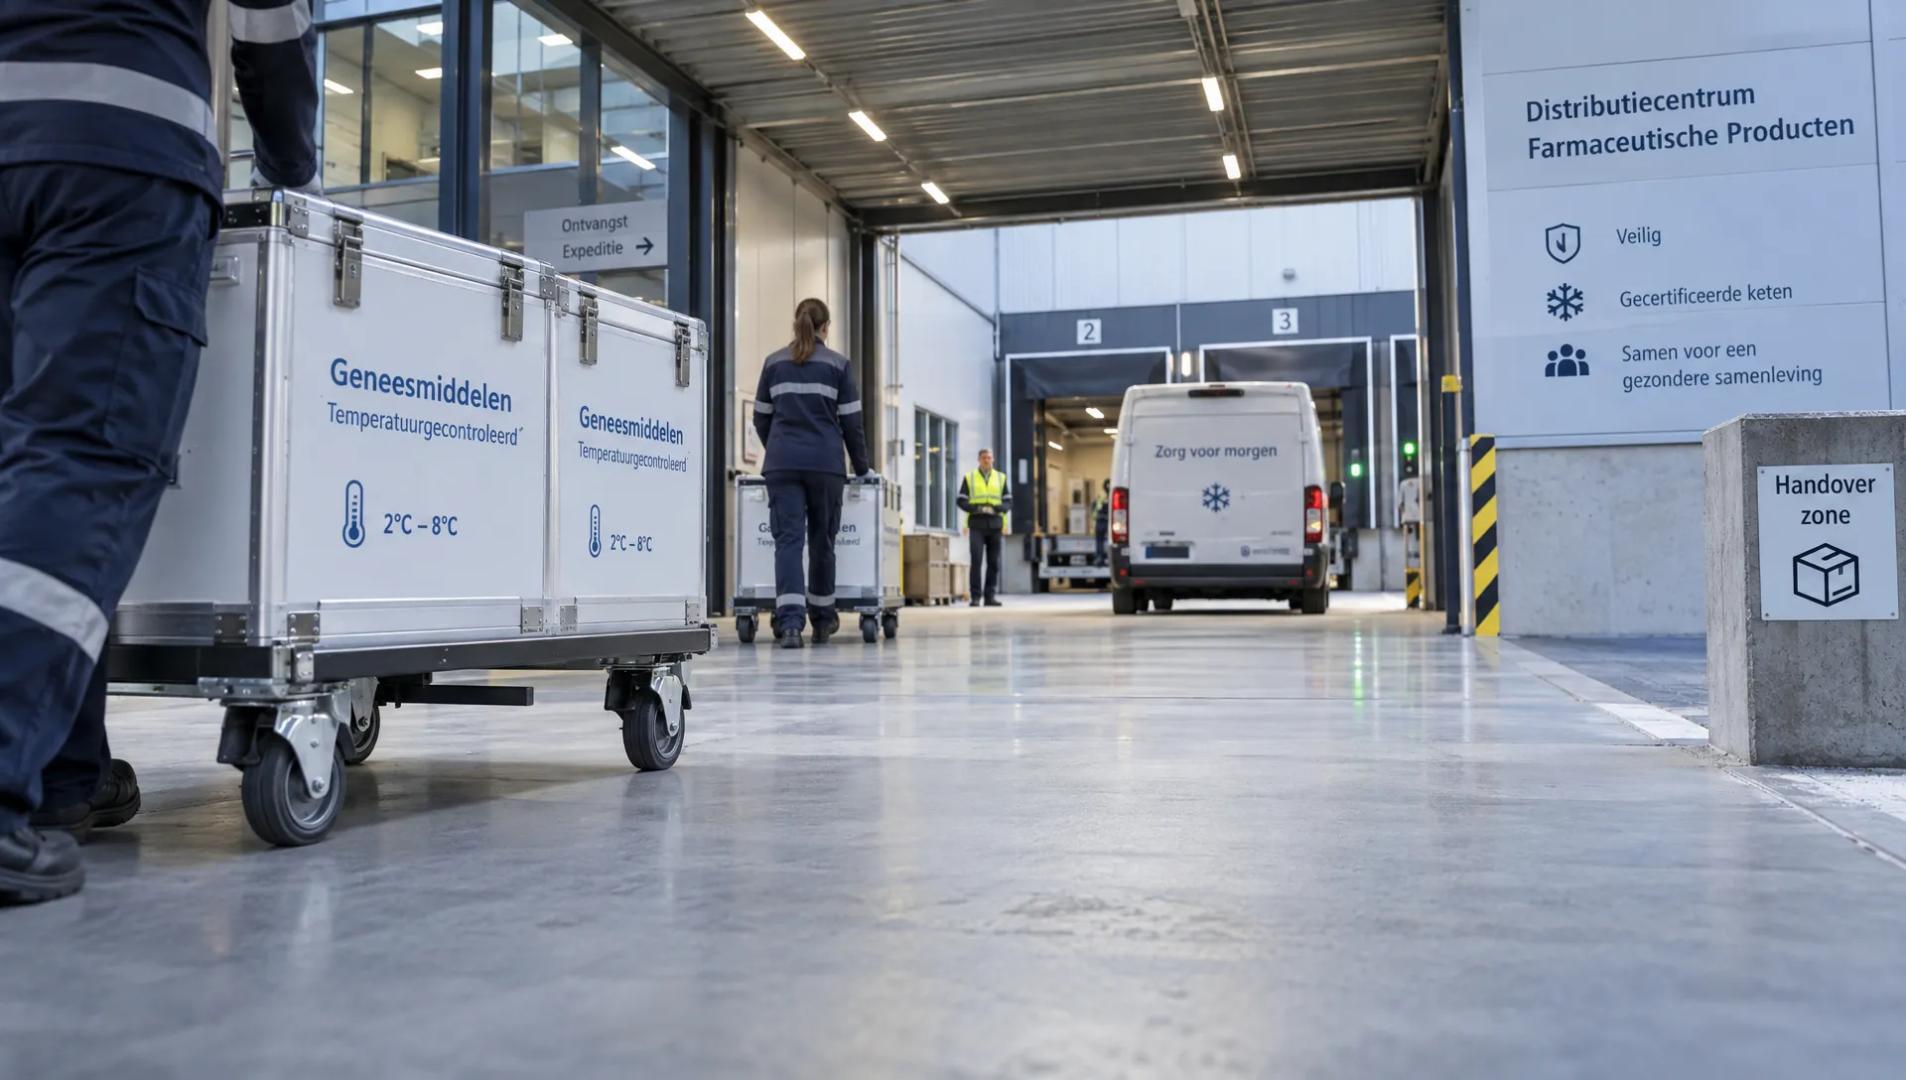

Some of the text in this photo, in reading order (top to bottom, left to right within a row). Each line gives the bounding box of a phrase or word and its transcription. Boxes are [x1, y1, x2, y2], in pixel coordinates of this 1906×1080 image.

[1526, 87, 1755, 122] Distributiecentrum
[1528, 116, 1855, 159] Farmaceutische Producten
[562, 215, 629, 233] Ontvangst
[1616, 226, 1662, 246] Veilig
[563, 241, 624, 260] Expeditie
[1620, 284, 1793, 307] Gecertificeerde keten
[1084, 322, 1095, 340] 2
[1280, 312, 1291, 330] 3
[1622, 344, 1757, 362] Samen voor een
[330, 357, 512, 413] Geneesmiddelen
[1622, 365, 1823, 392] gezondere samenleving
[579, 405, 684, 445] Geneesmiddelen
[578, 440, 687, 472] Temperatuurgecontroleerd
[1155, 445, 1277, 461] Zorg voor morgen
[1775, 473, 1876, 495] Handover
[1801, 508, 1851, 525] zone
